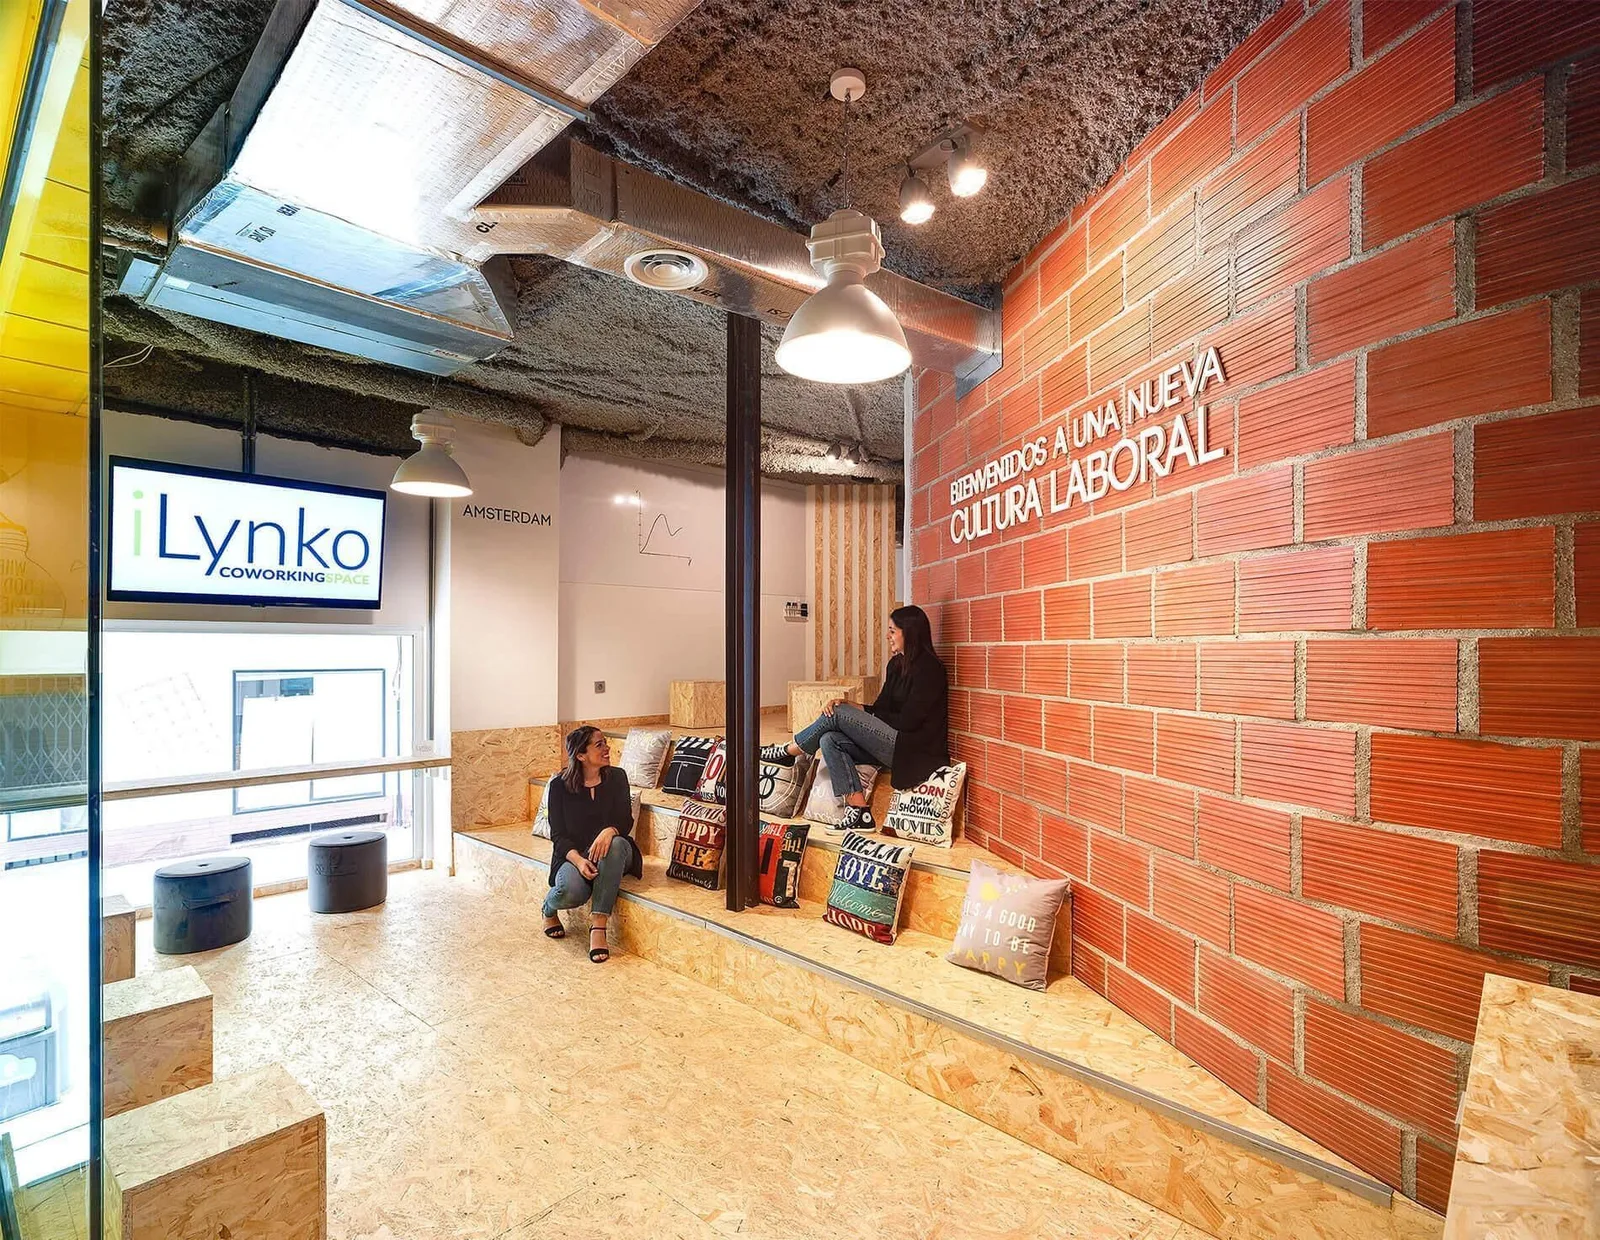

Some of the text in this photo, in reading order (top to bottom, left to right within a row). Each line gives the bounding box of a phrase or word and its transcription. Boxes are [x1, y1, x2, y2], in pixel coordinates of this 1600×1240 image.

[476, 221, 498, 233] CL
[950, 346, 1227, 505] BIENVENIDOS A UNA NUEVA
[950, 405, 1227, 544] CULTURA LABORAL
[463, 504, 551, 526] AMSTERDAM
[133, 490, 370, 576] iLynko
[948, 766, 961, 788] ONE
[899, 803, 941, 818] SHOWING
[910, 796, 932, 806] NOW
[889, 817, 945, 837] MOVIES
[836, 854, 886, 891] LOVE
[985, 905, 993, 919] A
[999, 909, 1036, 933] GOOD
[985, 928, 1001, 946] TO
[1010, 935, 1031, 955] BE
